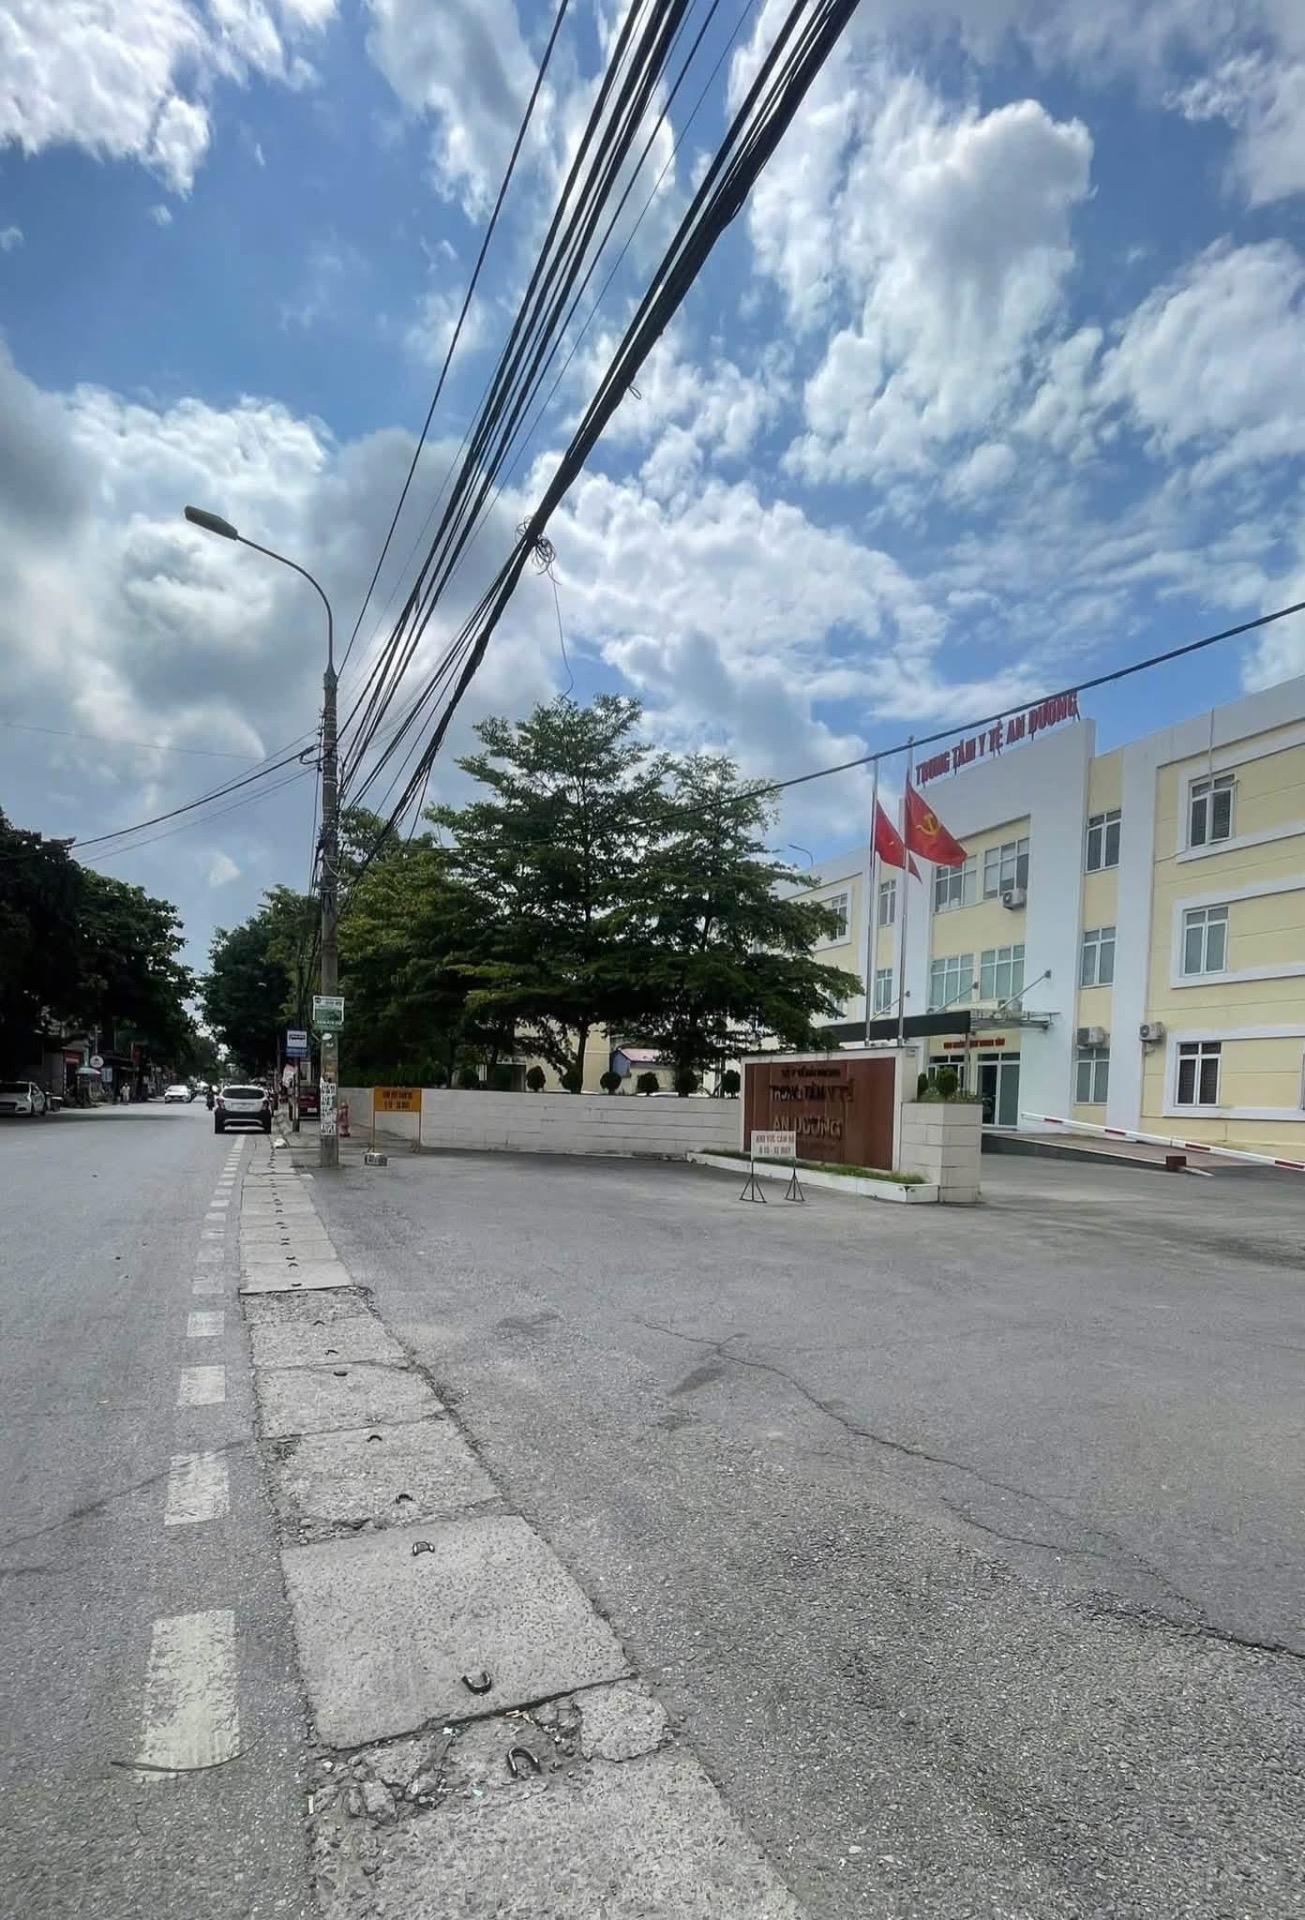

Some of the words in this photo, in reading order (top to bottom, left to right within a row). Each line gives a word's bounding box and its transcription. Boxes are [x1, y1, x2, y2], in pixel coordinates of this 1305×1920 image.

[916, 751, 950, 785] TRUNG
[979, 732, 987, 757] Y
[1007, 714, 1026, 745] AN
